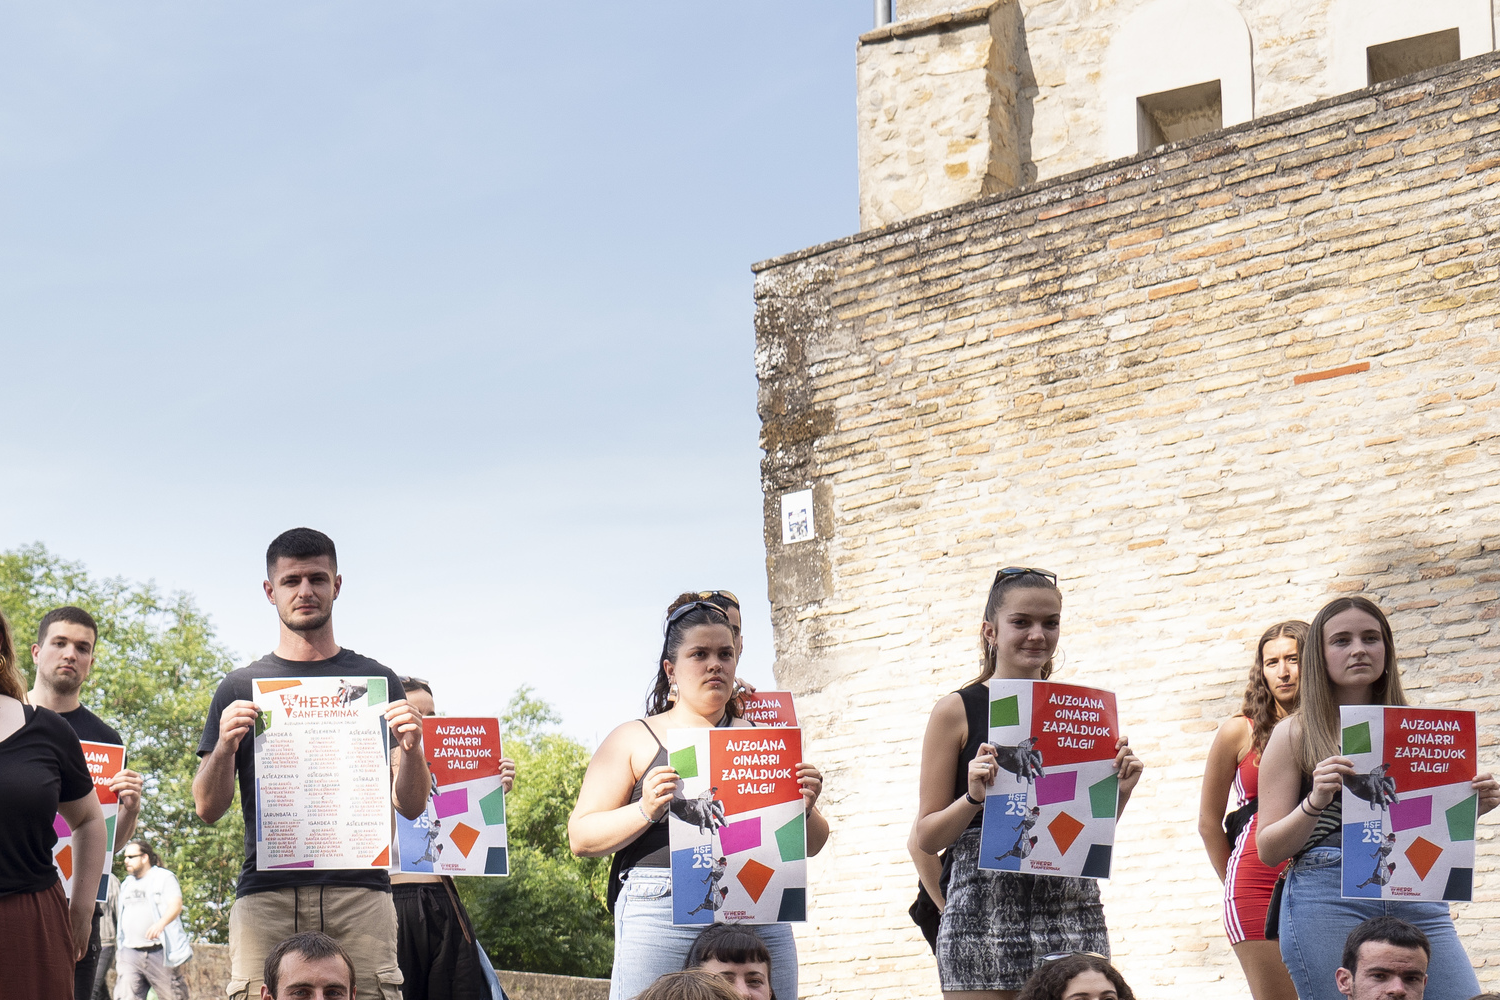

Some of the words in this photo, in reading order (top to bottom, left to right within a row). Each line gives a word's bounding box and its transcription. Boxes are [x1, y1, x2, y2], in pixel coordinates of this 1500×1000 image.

[1049, 693, 1104, 710] AUZOLANA
[292, 710, 359, 718] SANFERMINAK
[1055, 709, 1100, 722] OINARRI
[436, 726, 486, 735] AUZOLANA
[1043, 721, 1110, 737] ZAPALDUOK
[1401, 719, 1460, 731] AUZOLANA
[442, 737, 481, 746] OINARRI
[1058, 737, 1094, 749] JALGI!
[1408, 733, 1453, 745] OINARRI
[726, 739, 786, 752] AUZOLANA
[434, 748, 491, 757] ZAPALDUOK
[1395, 747, 1465, 759] ZAPALDUOK
[447, 760, 478, 769] JALGI!
[733, 754, 780, 766] OINARRI
[1411, 761, 1449, 773] JALGI!
[722, 768, 791, 780] ZAPALDUOK
[738, 783, 775, 794] JALGI!
[1005, 801, 1027, 817] 25
[413, 817, 429, 829] 25
[1362, 828, 1382, 843] 25
[692, 854, 713, 869] 25
